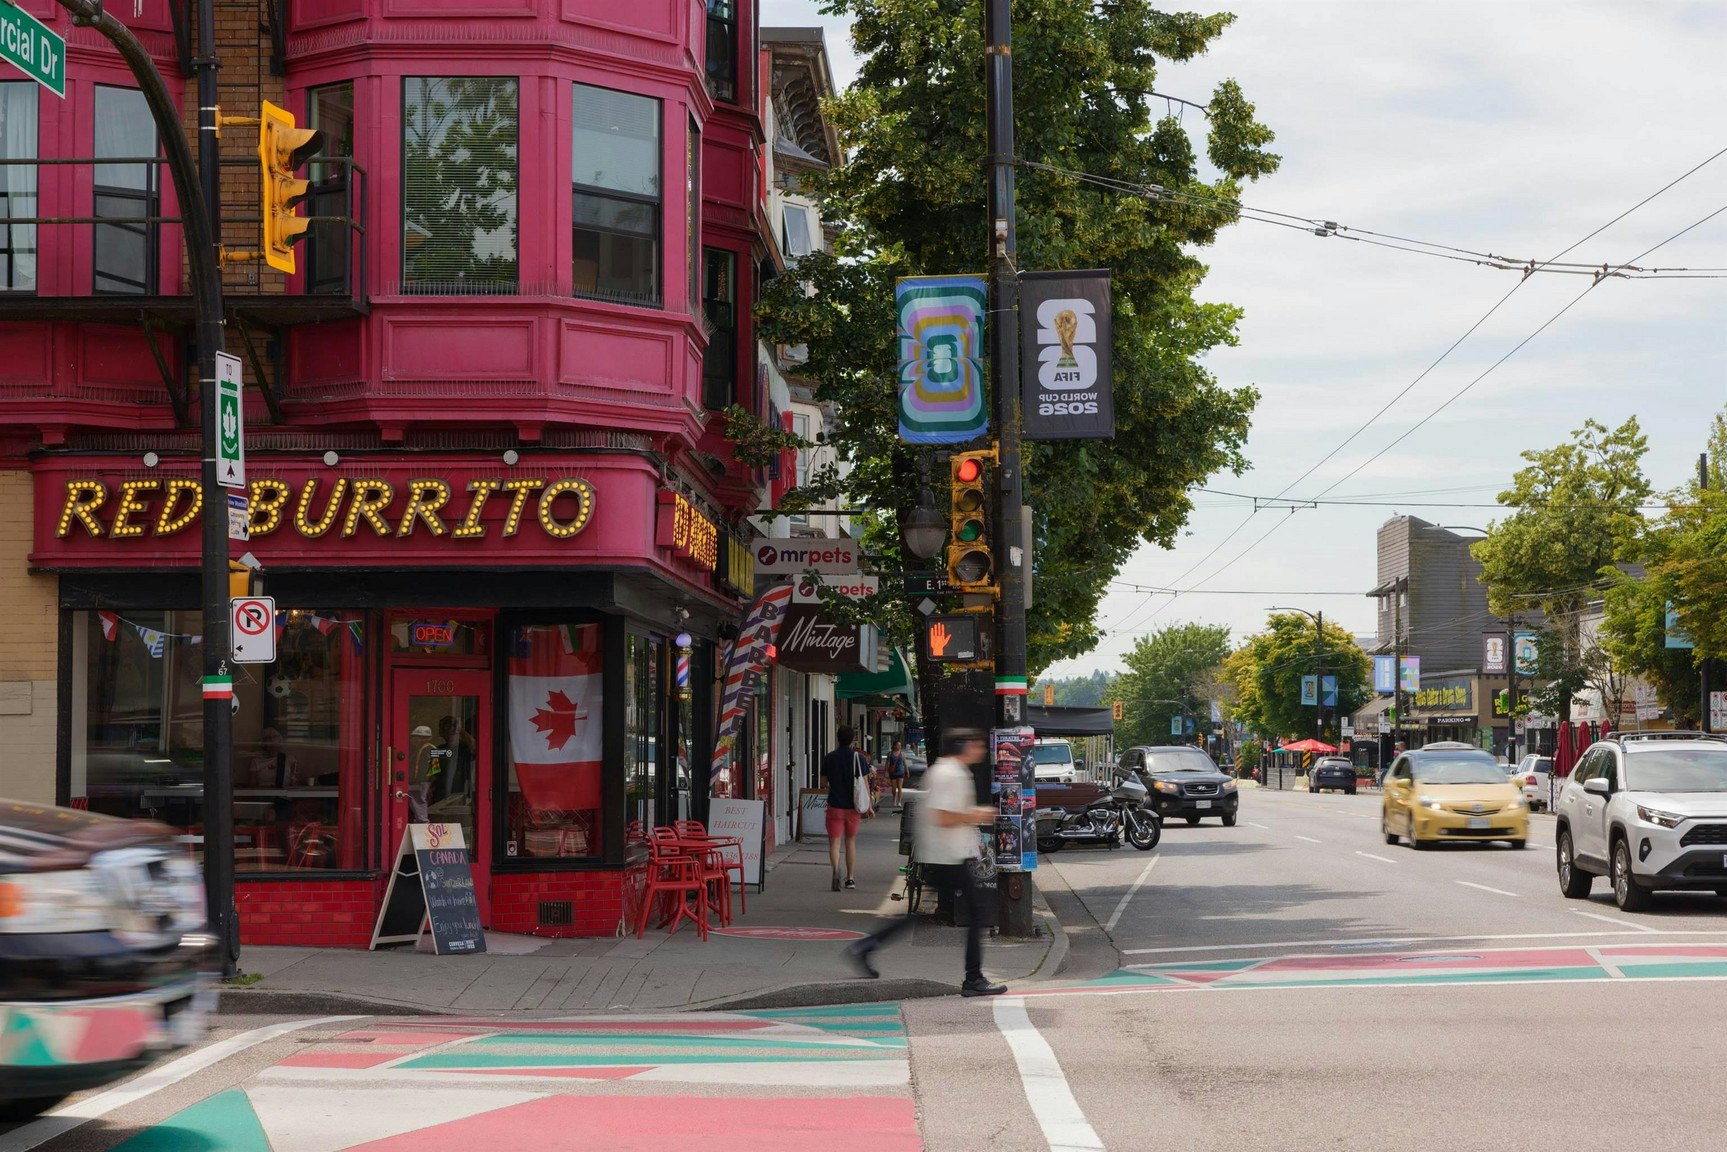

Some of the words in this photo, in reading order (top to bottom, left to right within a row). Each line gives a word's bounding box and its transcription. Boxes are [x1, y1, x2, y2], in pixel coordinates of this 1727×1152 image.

[41, 35, 58, 79] Dr
[226, 363, 233, 376] TO
[54, 477, 203, 540] RED
[248, 476, 598, 540] BURRITO
[780, 547, 852, 567] mrpets
[926, 580, 935, 590] E.
[937, 580, 947, 590] 1st
[415, 626, 453, 642] OPEN
[781, 615, 855, 659] Mintage
[724, 806, 748, 815] BEST
[713, 820, 758, 831] HAIRCUT
[429, 851, 466, 866] CANADA
